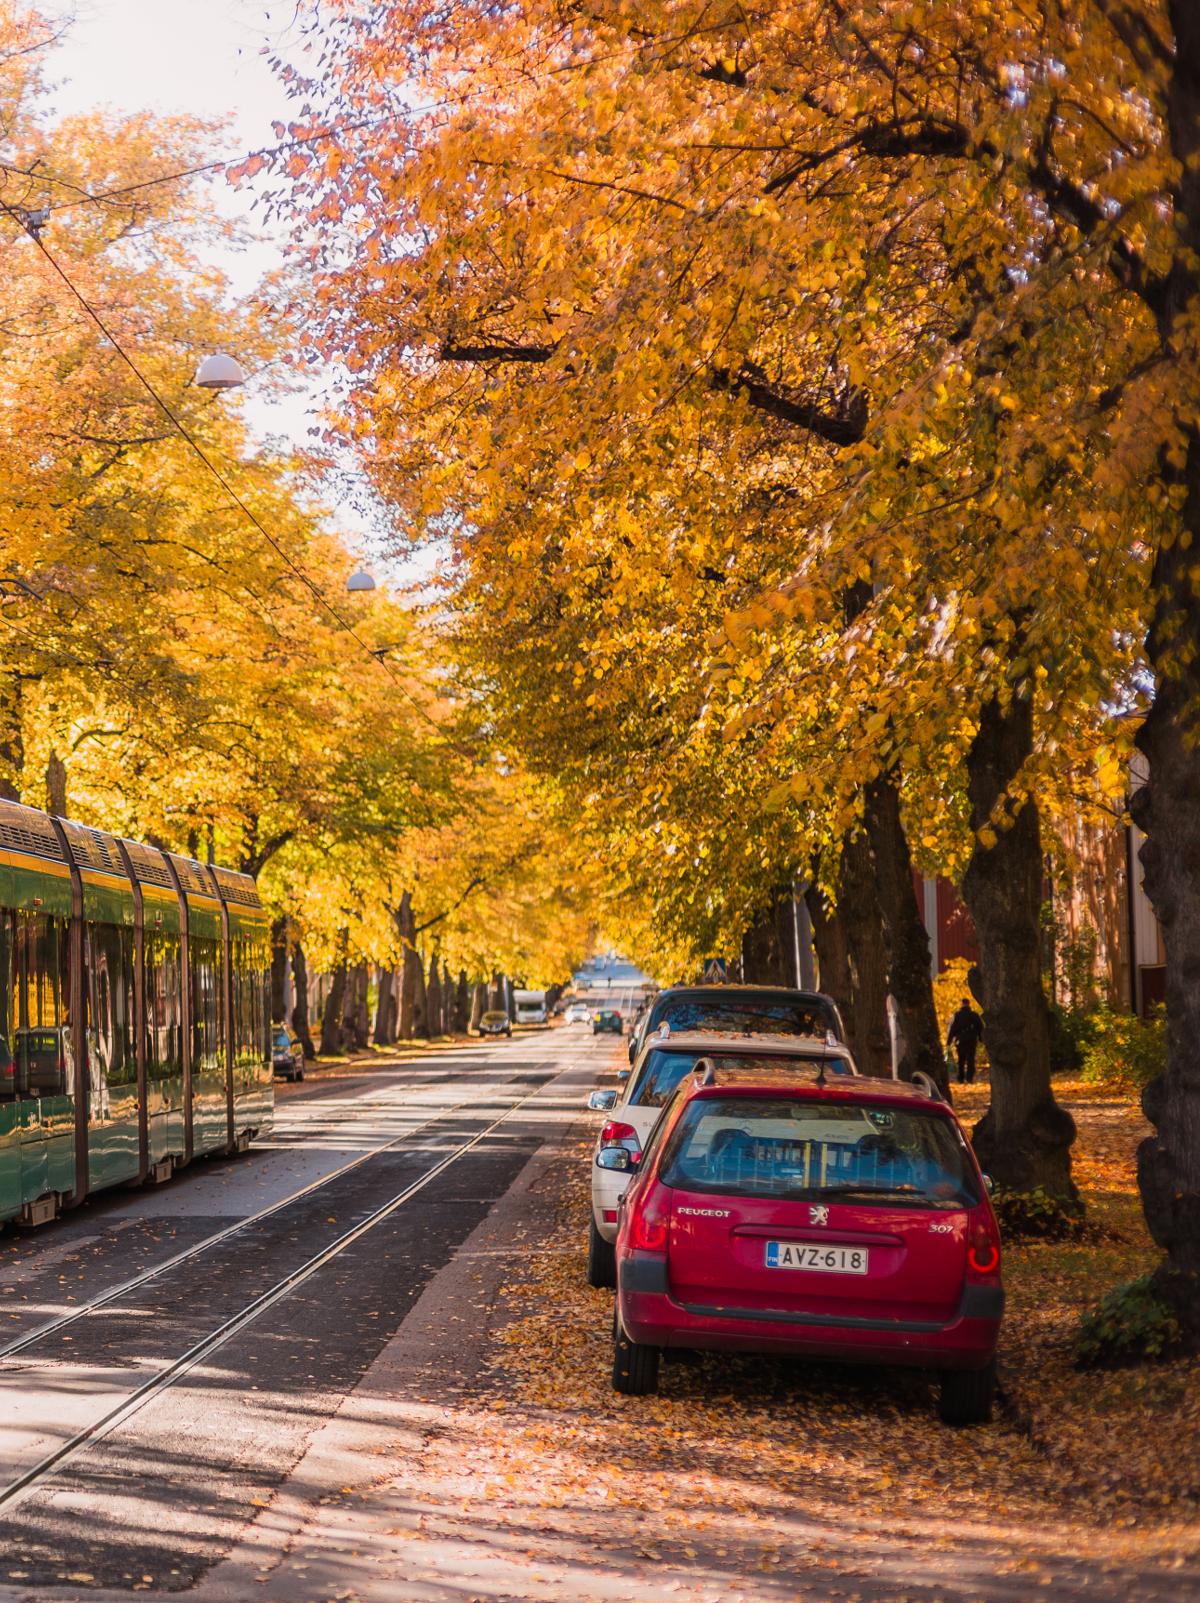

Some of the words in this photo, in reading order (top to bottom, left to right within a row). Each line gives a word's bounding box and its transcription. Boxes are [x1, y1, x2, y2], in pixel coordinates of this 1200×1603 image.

[677, 1207, 731, 1218] PEUGEOT
[928, 1224, 954, 1234] 307
[782, 1246, 862, 1269] AVZ-618
